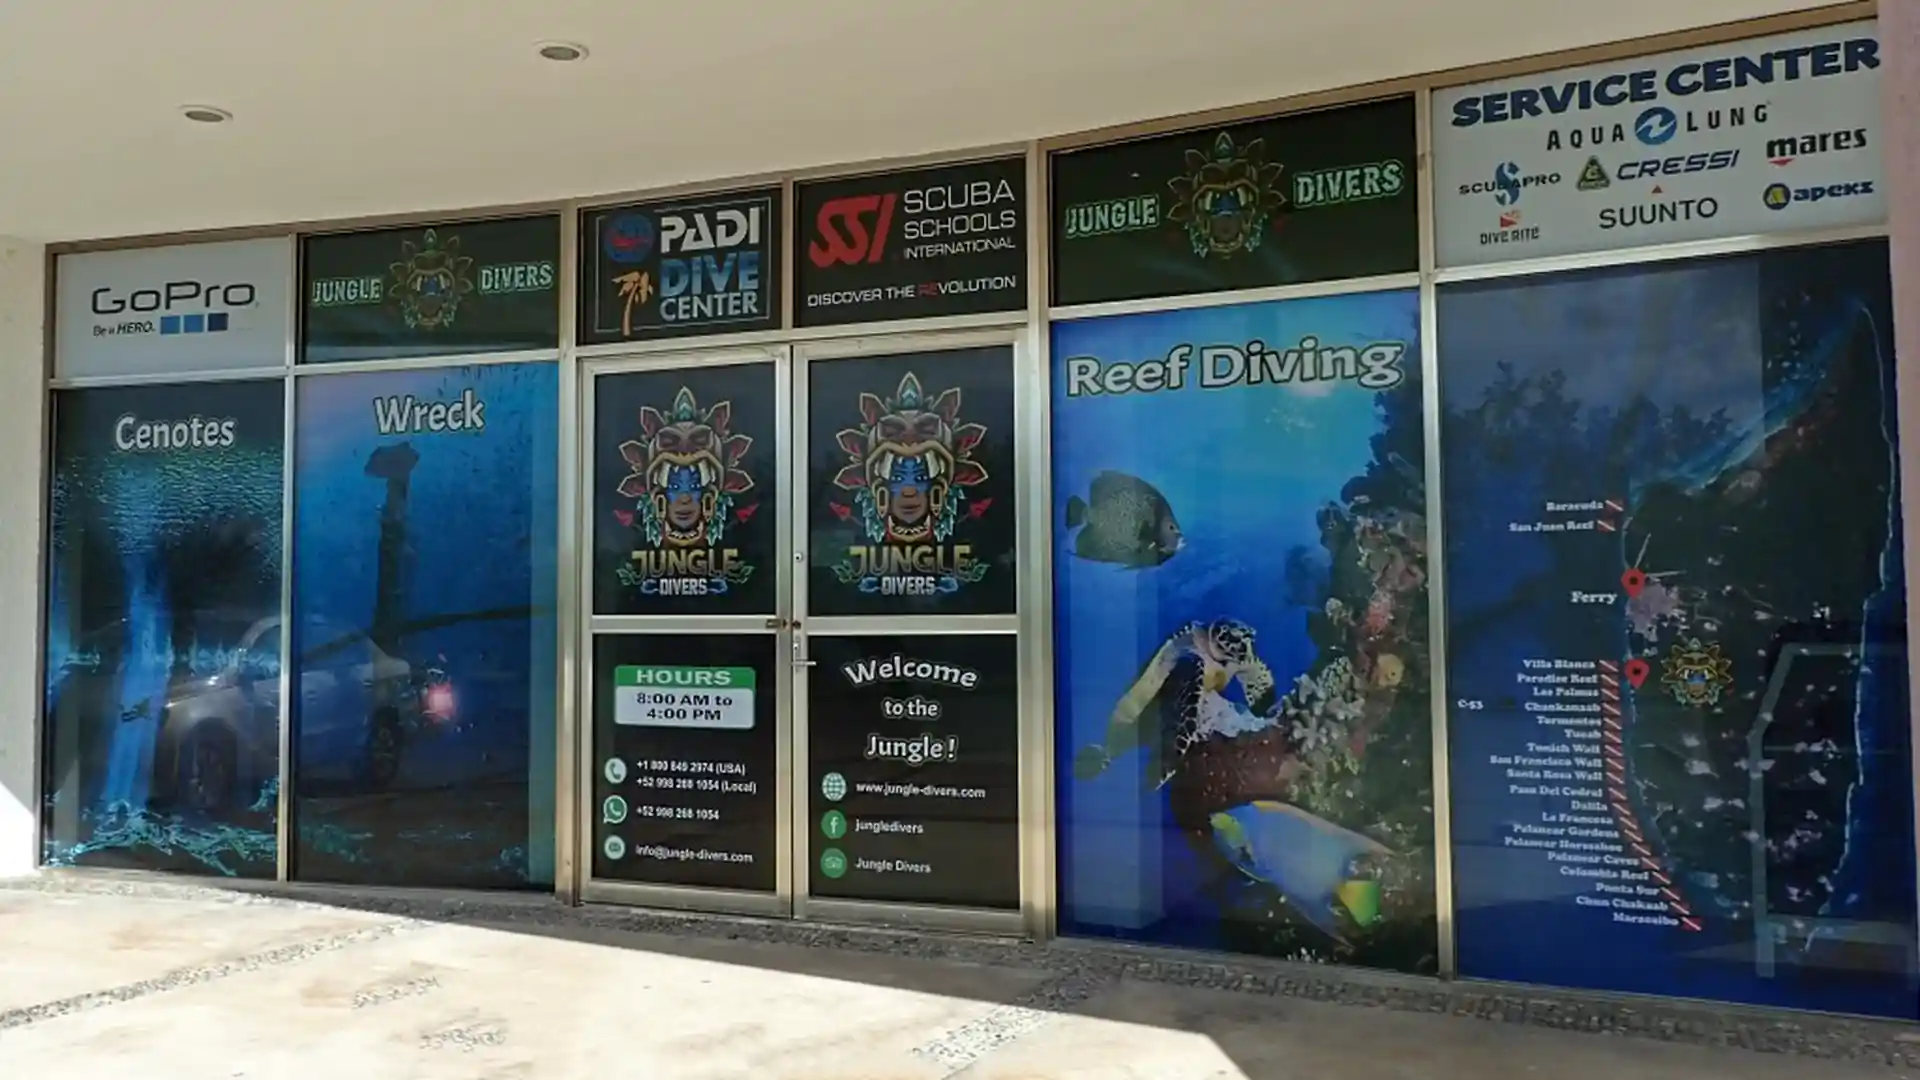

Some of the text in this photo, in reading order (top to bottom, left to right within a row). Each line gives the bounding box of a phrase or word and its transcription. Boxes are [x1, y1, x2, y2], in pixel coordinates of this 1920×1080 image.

[1451, 38, 1880, 127] SERVICE CENTER
[1547, 104, 1768, 151] AQUA LUNG
[1767, 128, 1867, 159] mares
[1617, 149, 1740, 181] CRESSI
[1459, 172, 1561, 196] SCUAPRO
[904, 181, 1016, 213] SCUBA
[1066, 160, 1404, 237] JUNGLE DIVERS
[1599, 197, 1718, 229] SUUNTO
[660, 207, 760, 253] PADI
[809, 193, 896, 268] SSI
[904, 210, 1016, 239] SCHOOLS
[1480, 226, 1540, 246] DIVE RITE
[904, 237, 1016, 260] INTERNATIONAL
[312, 263, 553, 304] JUNGLE DIVERS
[660, 251, 759, 297] DIVE
[92, 281, 256, 315] GoPro
[808, 275, 1016, 307] DISCOVER THE REVOLUTION
[660, 291, 758, 321] CENTER
[93, 326, 106, 337] Be
[1067, 337, 1405, 396] Reef Diving
[374, 390, 484, 433] Wreck
[115, 415, 235, 451] Cenotes
[1509, 520, 1594, 532] San Juan Reef
[632, 548, 739, 577] JUNGLE
[849, 545, 974, 576] JUNGLE
[659, 577, 709, 596] DIVERS
[881, 576, 936, 596] DIVERS
[1571, 591, 1618, 605] Ferry
[843, 655, 979, 688] Welcome
[1523, 659, 1596, 669] Villa Blanca
[636, 669, 732, 686] HOURS
[1570, 674, 1598, 684] Reef
[636, 692, 733, 707] 8:00 AM to
[884, 698, 939, 717] to the
[1458, 699, 1484, 711] C-53
[646, 708, 722, 721] 4:00 PM
[1572, 744, 1600, 754] Wall
[637, 760, 648, 770] +1
[715, 763, 746, 777] (USA)
[1490, 755, 1512, 764] San
[1574, 757, 1602, 768] Wall
[1506, 768, 1602, 780] Santa Rosa Wall
[637, 776, 654, 788] +52
[721, 781, 757, 795] (Local)
[855, 782, 986, 799] www.jungle-divers.com
[1539, 785, 1560, 796] Del
[637, 805, 654, 817] +52
[1542, 812, 1556, 822] La
[854, 819, 924, 835] jungledivers
[1568, 826, 1620, 839] Gardens
[635, 843, 754, 863] info@jungle-divers.com
[854, 857, 932, 874] Jungle Divers
[1621, 869, 1650, 880] Reef
[1596, 882, 1634, 894] Punta
